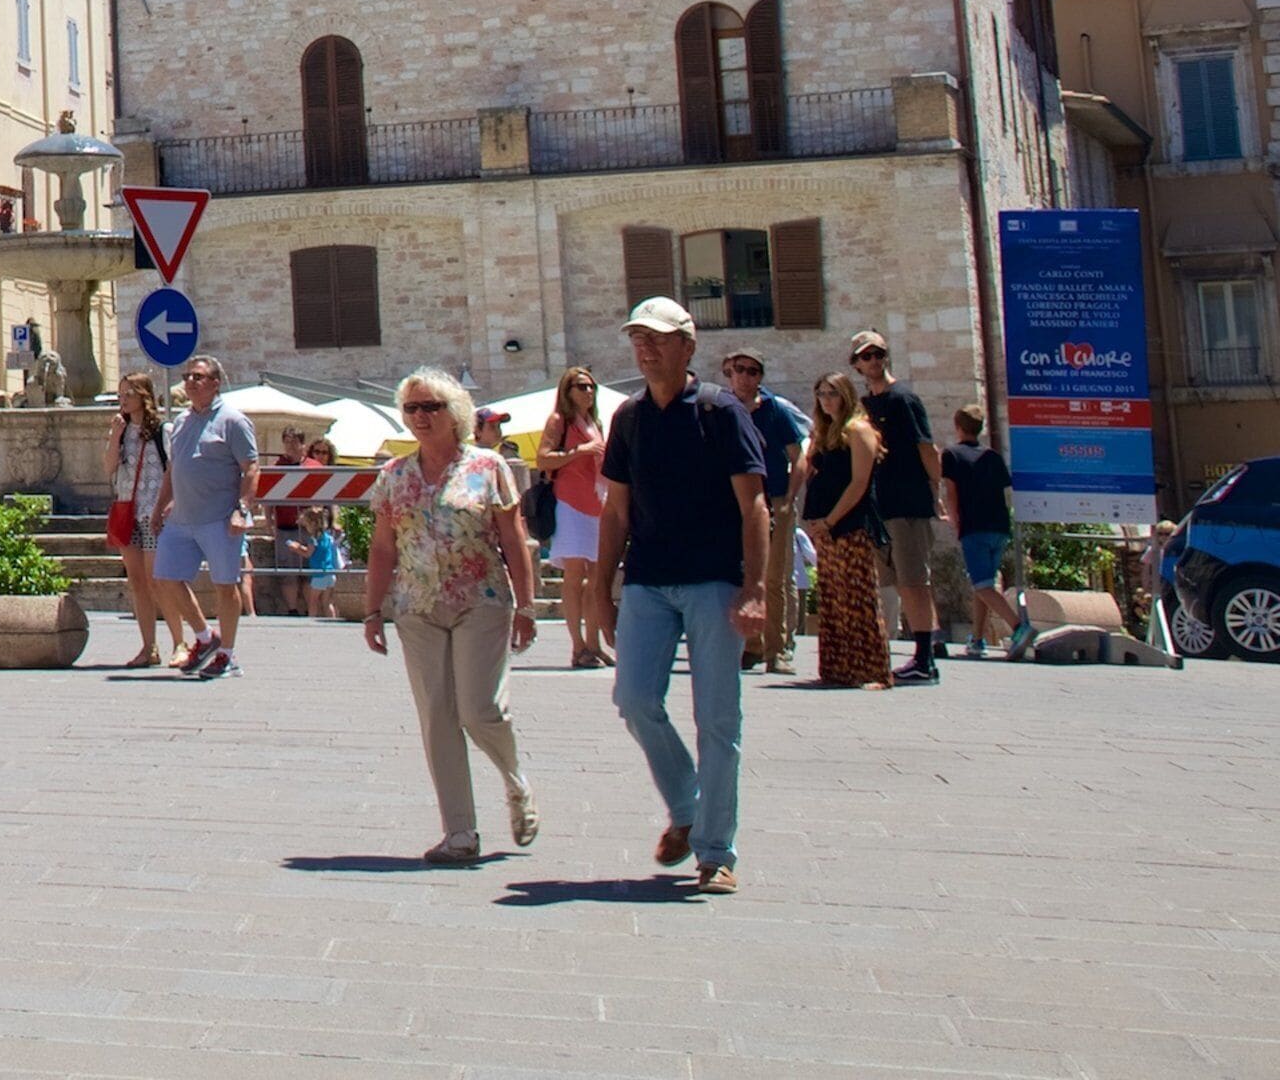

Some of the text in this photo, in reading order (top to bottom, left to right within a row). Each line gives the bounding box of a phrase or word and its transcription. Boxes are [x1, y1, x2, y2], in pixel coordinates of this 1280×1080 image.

[1038, 270, 1104, 278] CARLO CONTI
[1010, 284, 1055, 292] SPANDAU
[1017, 292, 1074, 301] FRANCESCA
[1026, 301, 1072, 310] LORENZO
[1030, 319, 1077, 328] MASSIMO
[15, 327, 25, 340] P
[1020, 349, 1050, 366] con
[1054, 343, 1068, 366] il
[1080, 370, 1128, 378] FRANCESCO
[1021, 383, 1052, 391] ASSISI
[1072, 384, 1112, 392] GIUGNO
